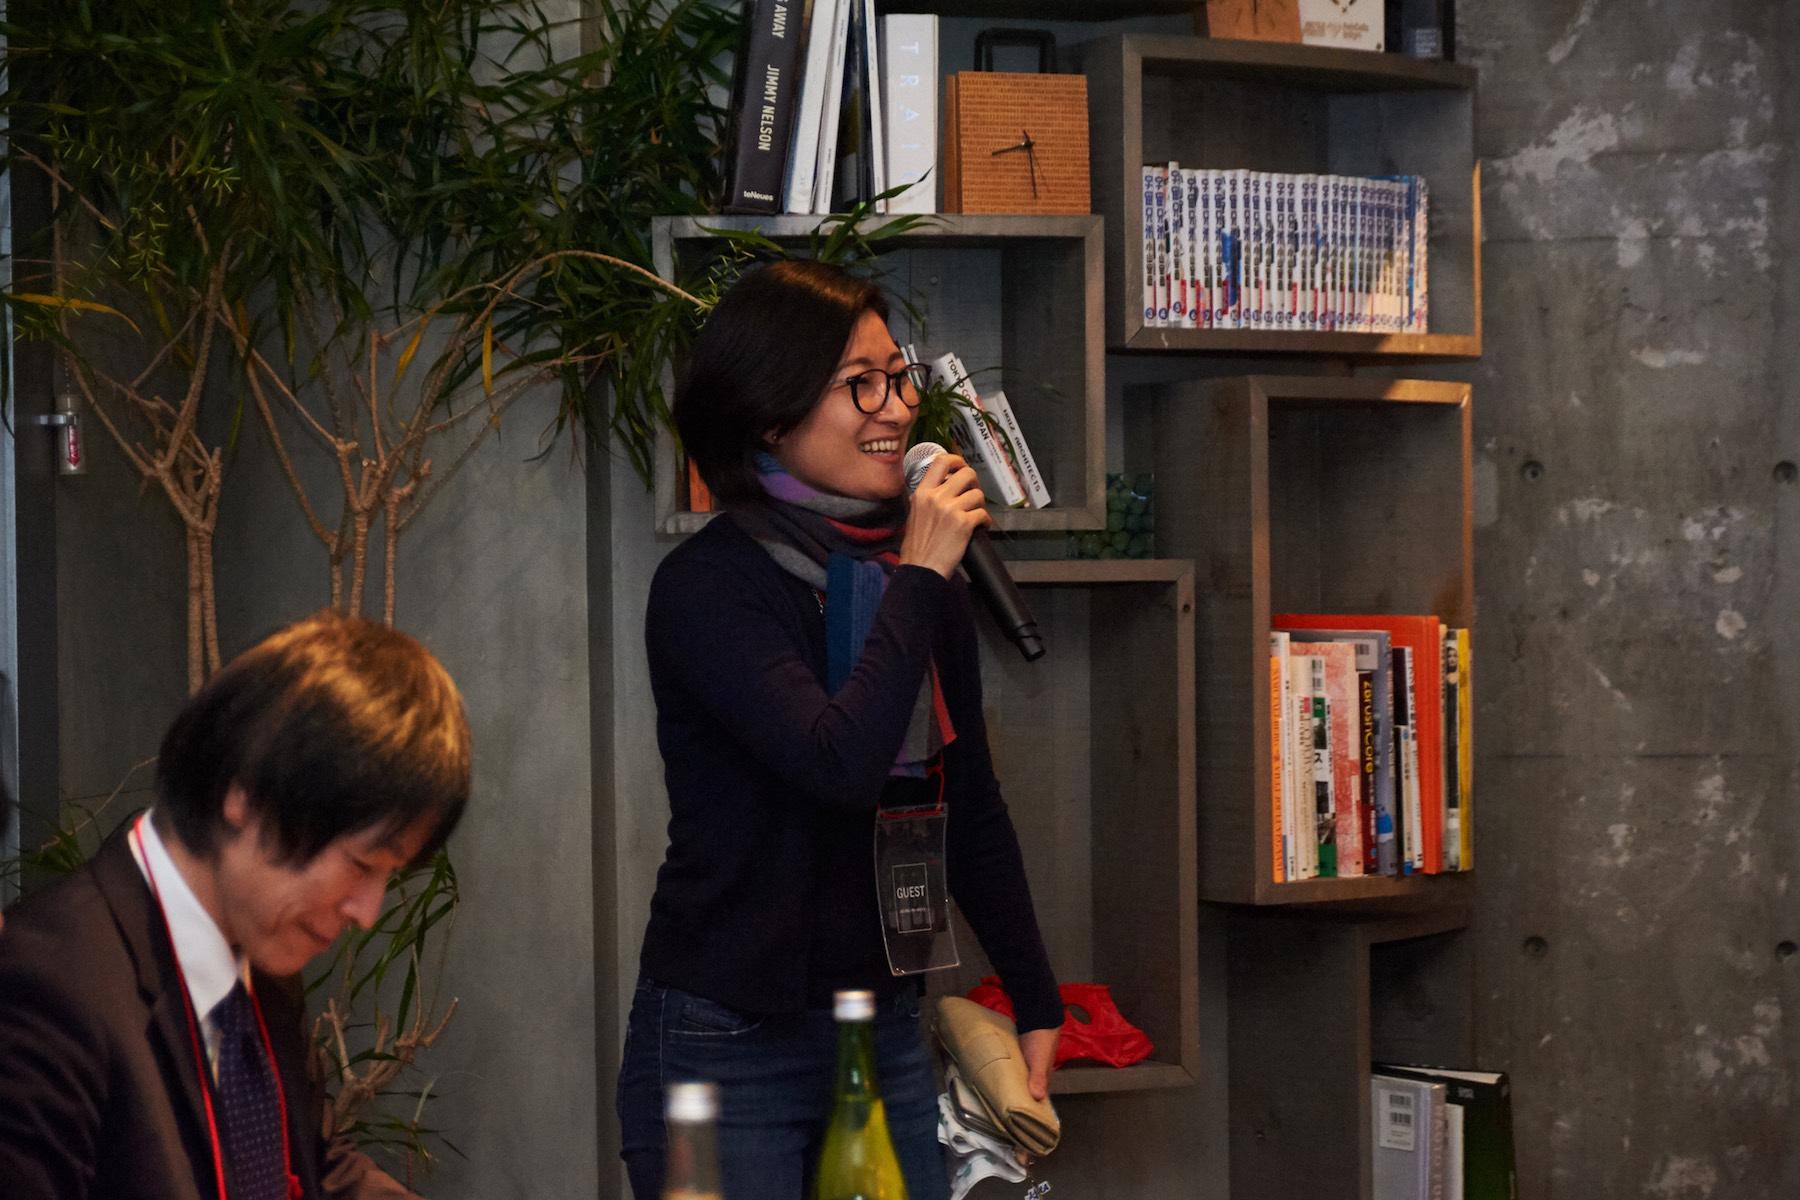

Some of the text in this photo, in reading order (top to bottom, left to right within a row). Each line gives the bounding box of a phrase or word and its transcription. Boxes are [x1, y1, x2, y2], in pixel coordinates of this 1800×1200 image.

[772, 3, 787, 39] AWAY
[758, 64, 780, 151] JIMMY NELSON
[744, 190, 773, 201] teNeues
[948, 359, 965, 388] TOKYO
[962, 389, 978, 413] COL
[972, 411, 990, 440] JAPAN
[1014, 436, 1041, 492] ARCHITECTS
[896, 885, 925, 899] GUEST
